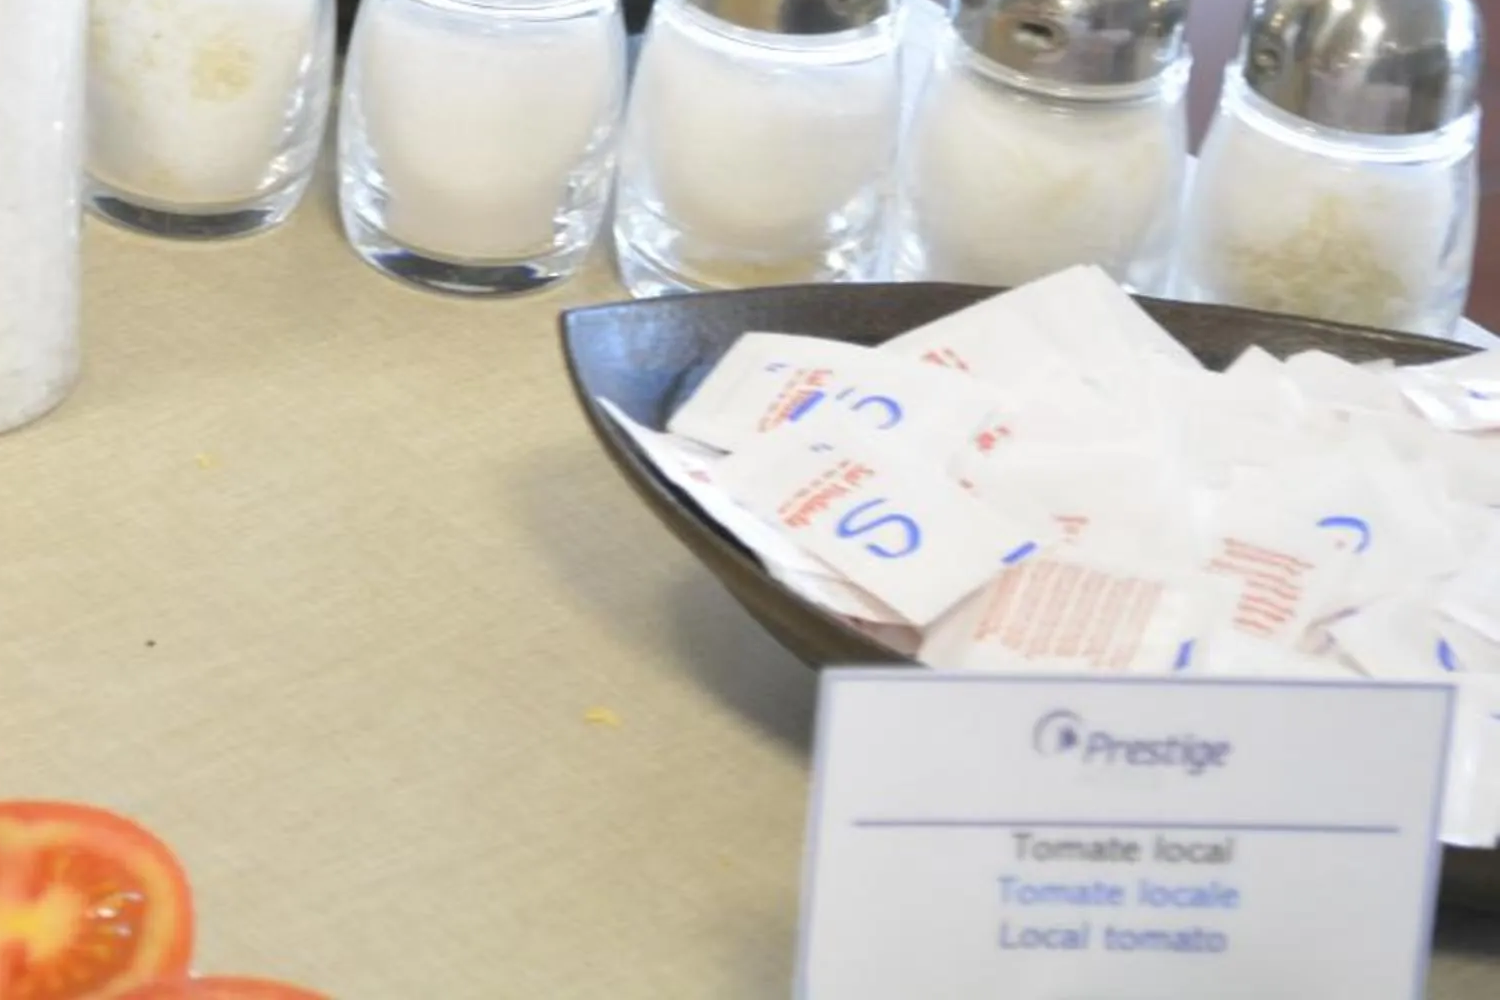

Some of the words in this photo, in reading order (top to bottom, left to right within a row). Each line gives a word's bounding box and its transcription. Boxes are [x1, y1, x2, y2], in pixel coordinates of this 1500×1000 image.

[1082, 731, 1231, 777] Prestige
[1011, 831, 1142, 864] Tomate
[1154, 833, 1236, 865] local
[997, 875, 1126, 906] Tomate
[1138, 880, 1241, 910] locale
[998, 920, 1091, 951] Local
[1104, 925, 1228, 953] tomato
